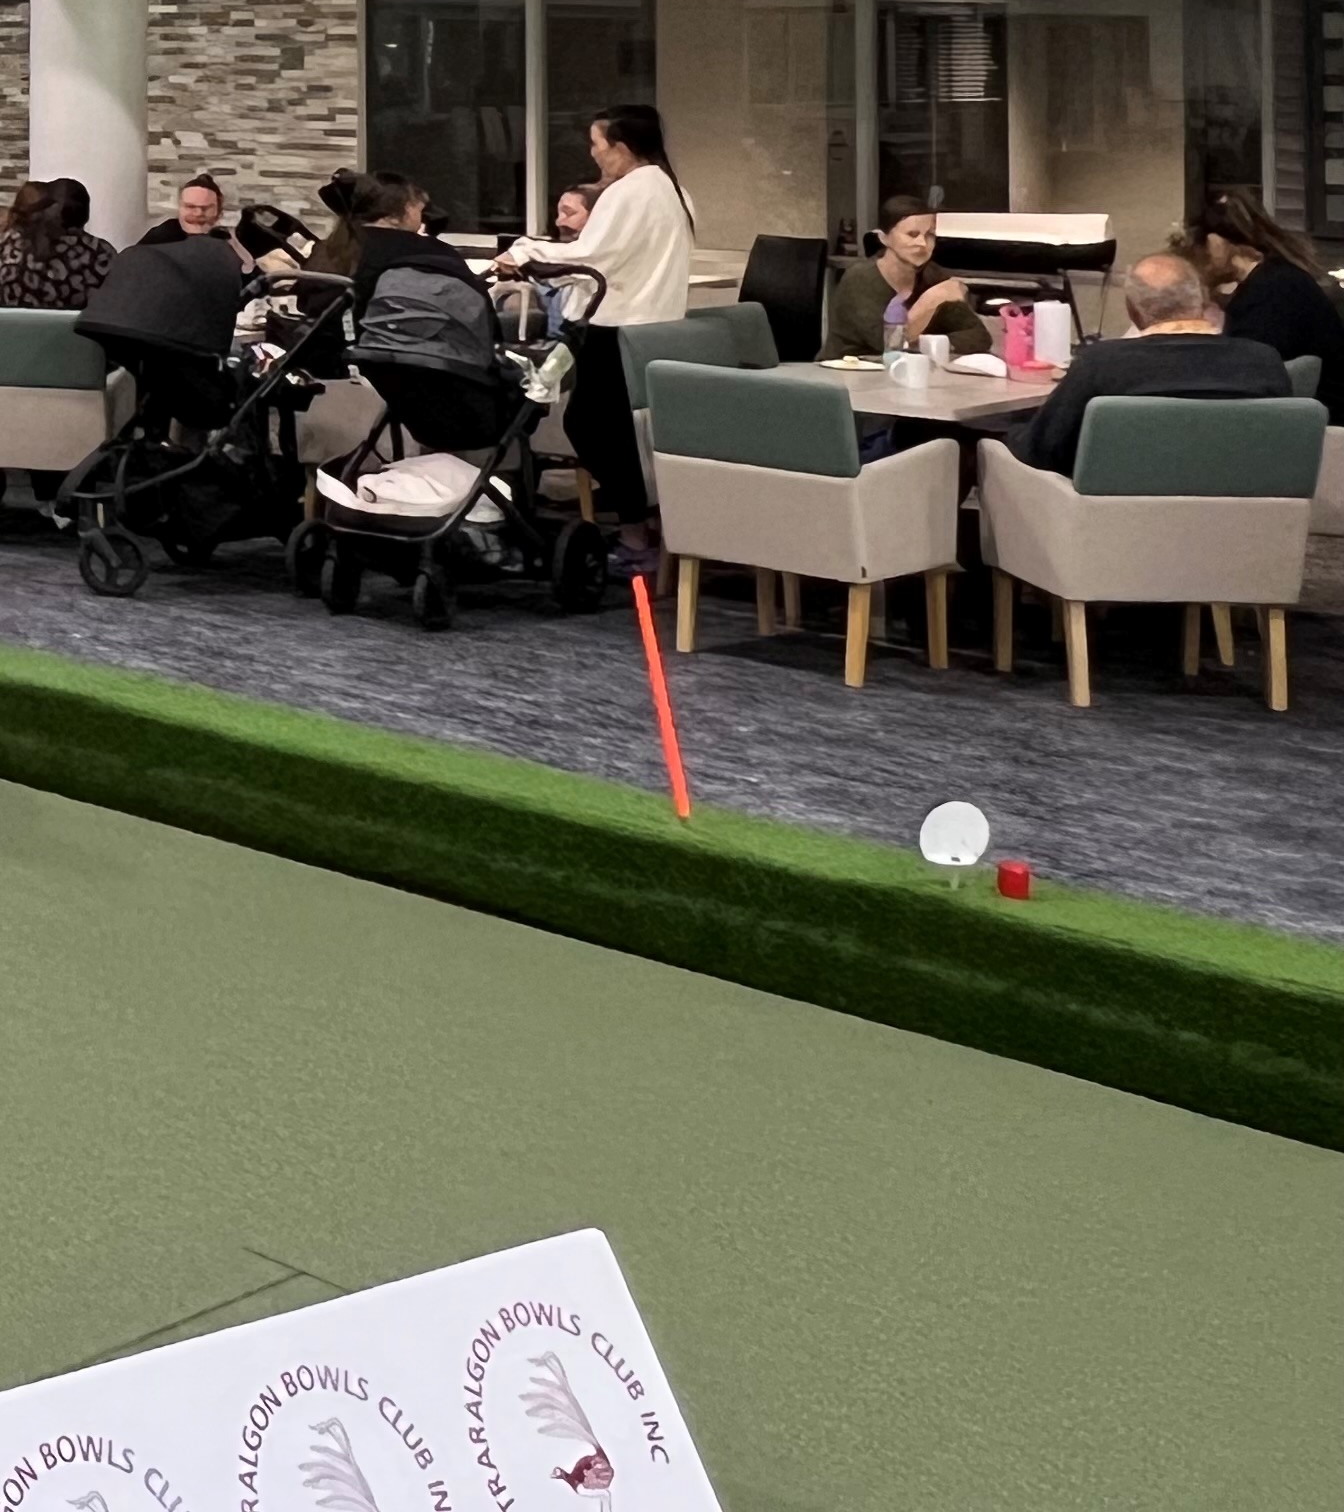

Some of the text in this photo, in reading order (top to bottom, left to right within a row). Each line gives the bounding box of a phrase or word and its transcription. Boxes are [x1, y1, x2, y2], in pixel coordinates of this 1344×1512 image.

[38, 1434, 136, 1474] BOWLS
[238, 1364, 453, 1512] RALGON BOWLS CLUB IN
[497, 1300, 582, 1337] BOWLS
[590, 1331, 646, 1401] CLUB
[639, 1410, 670, 1465] INC
